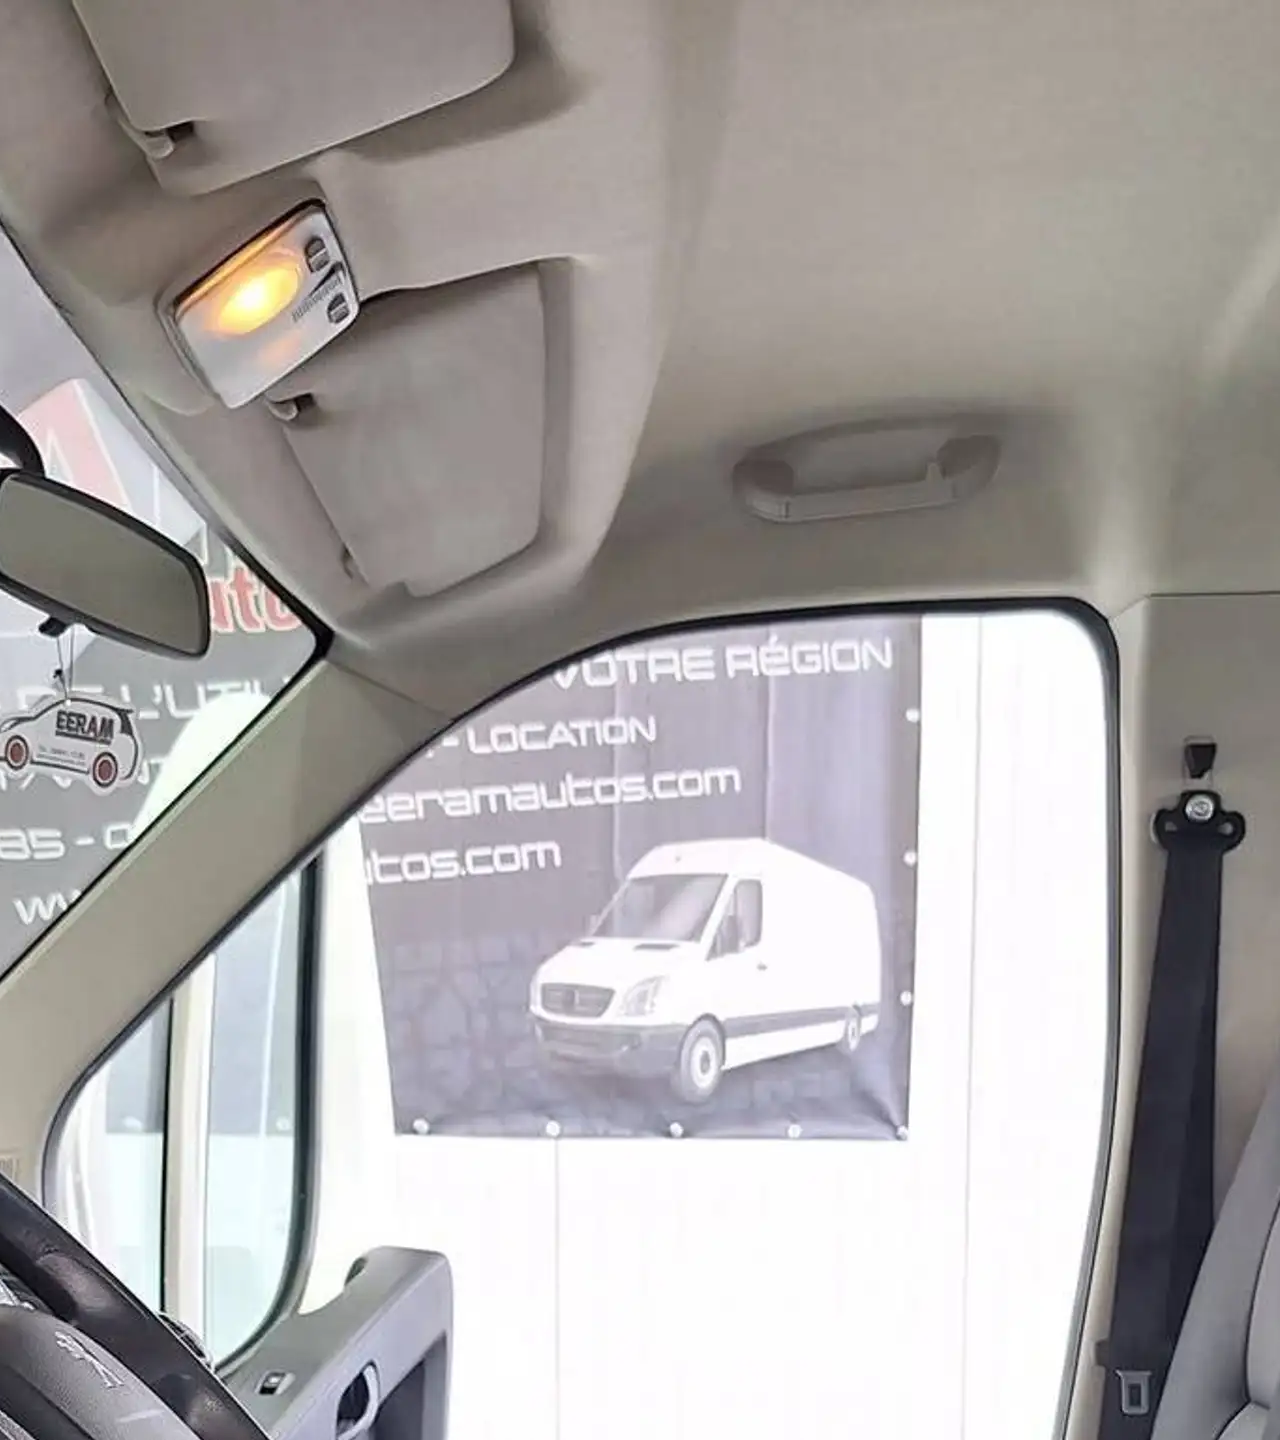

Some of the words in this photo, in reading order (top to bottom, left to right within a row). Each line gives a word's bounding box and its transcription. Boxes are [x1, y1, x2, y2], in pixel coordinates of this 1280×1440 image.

[55, 709, 115, 742] EERAM
[467, 715, 656, 754] LOCATION
[358, 766, 742, 824] eeramautos.com
